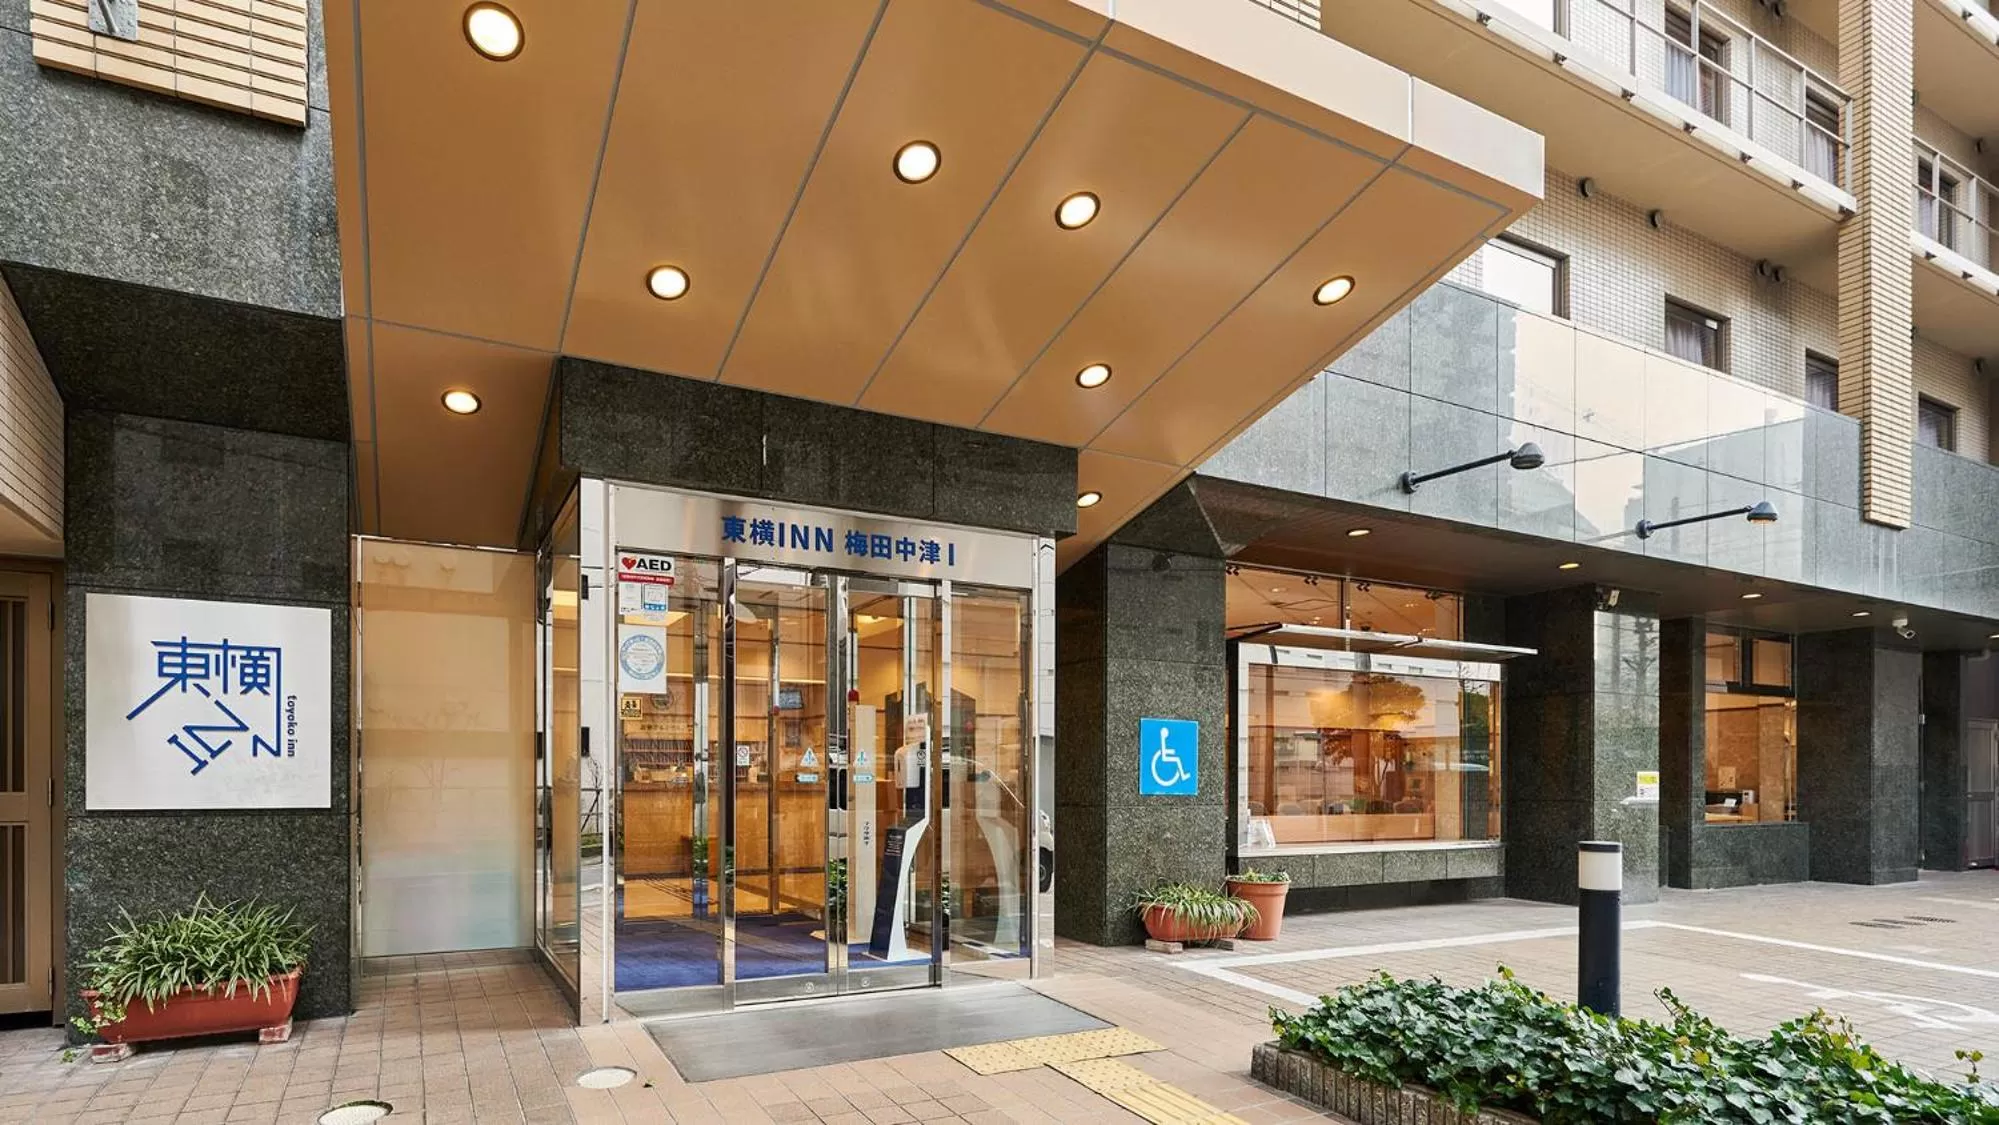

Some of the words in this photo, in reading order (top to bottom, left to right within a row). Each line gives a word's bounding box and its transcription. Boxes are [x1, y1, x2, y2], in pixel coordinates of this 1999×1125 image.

[721, 514, 834, 553] 東横INN
[636, 558, 672, 571] AED
[285, 694, 298, 736] toyoko
[286, 739, 298, 758] inn
